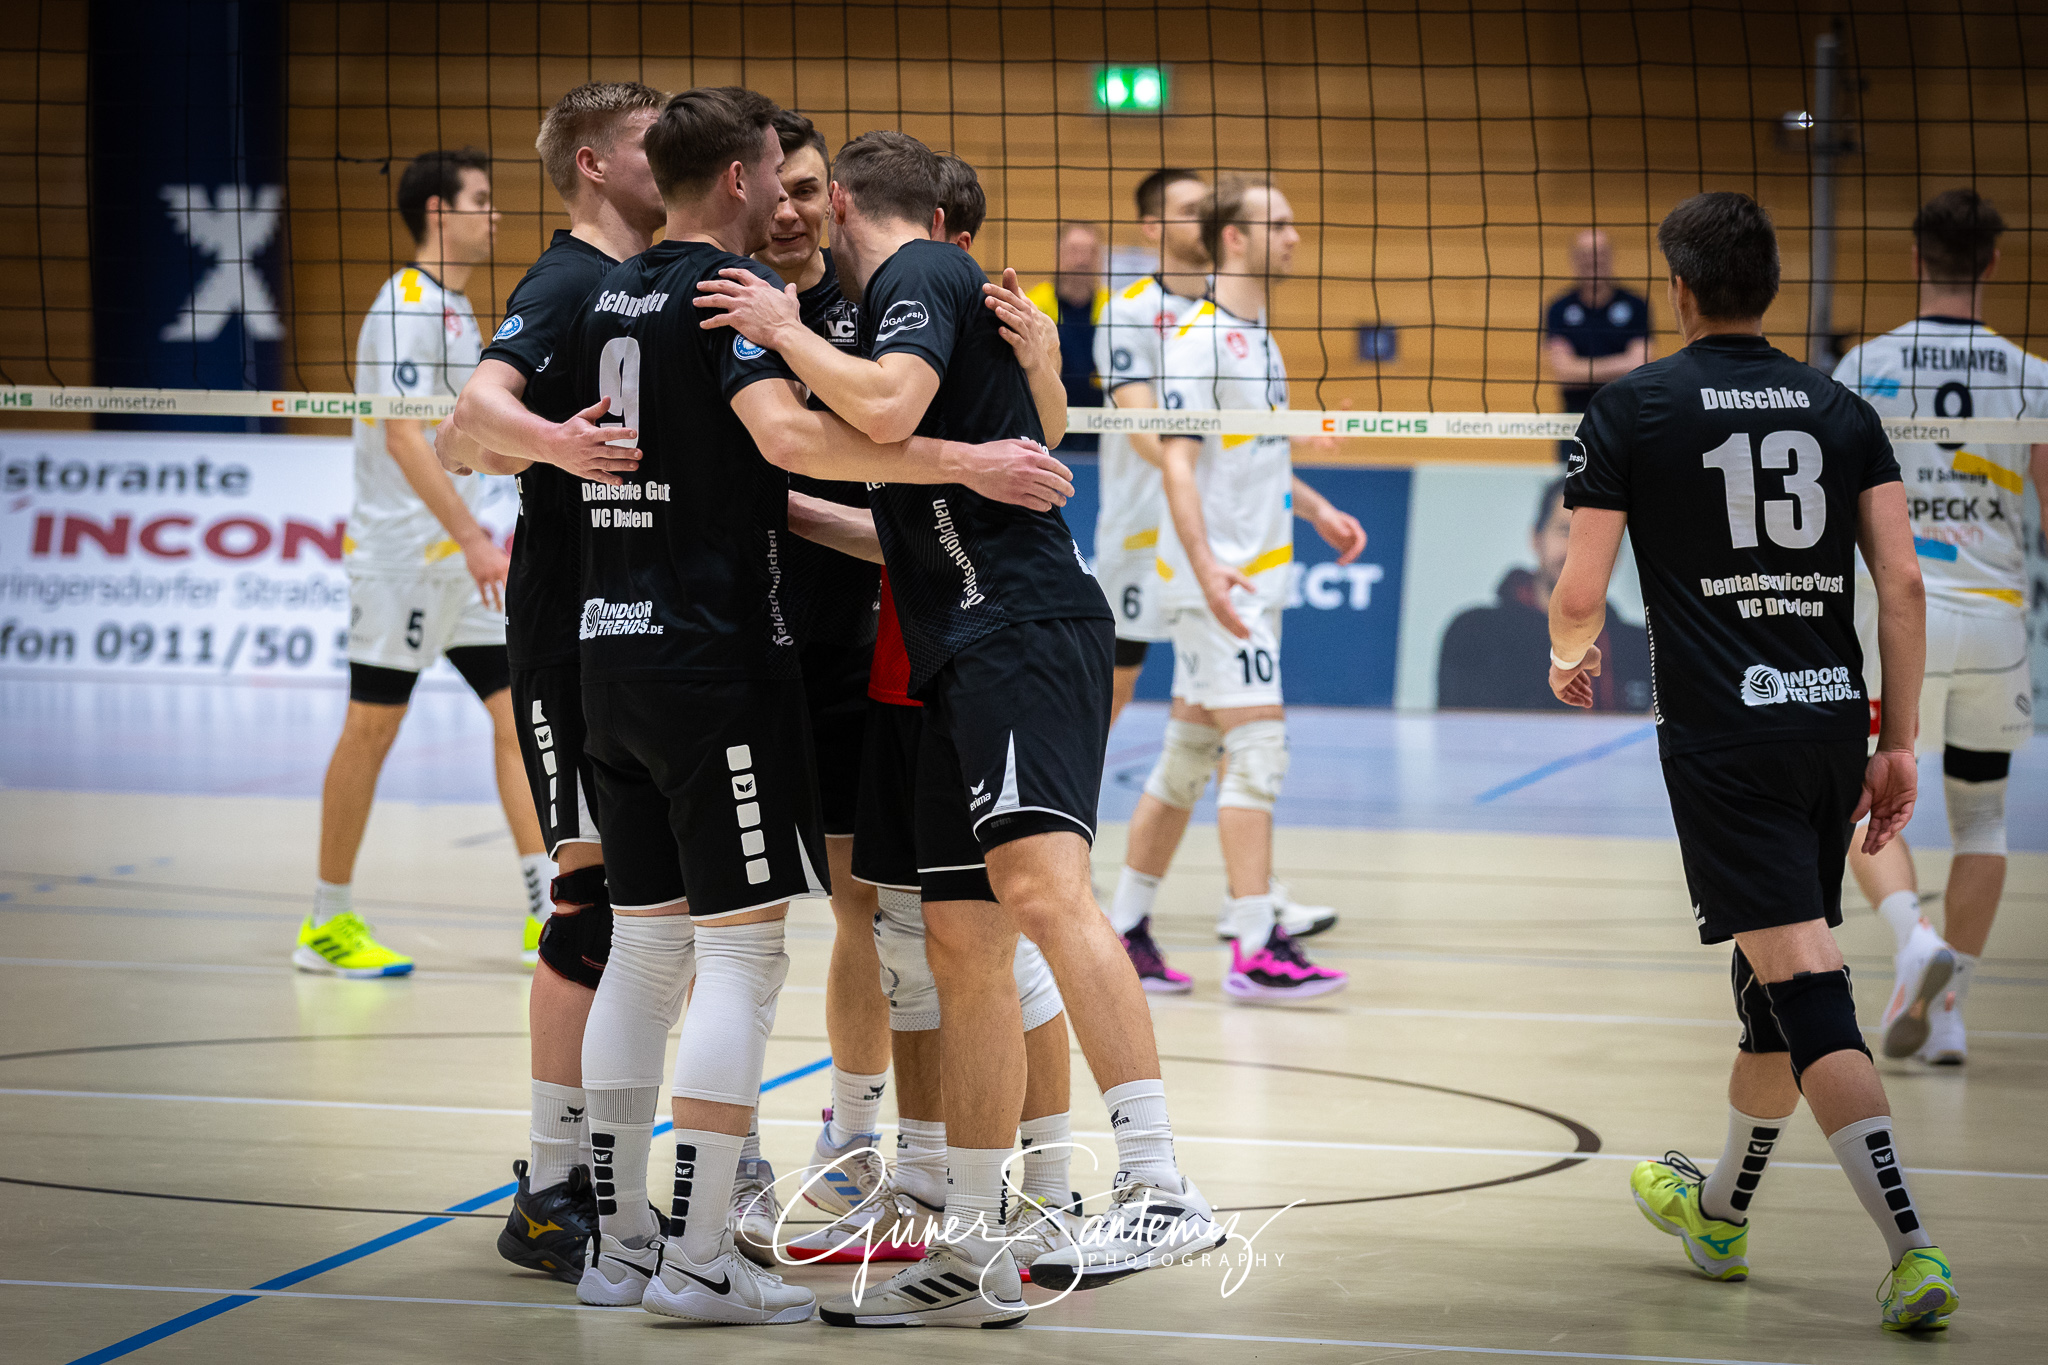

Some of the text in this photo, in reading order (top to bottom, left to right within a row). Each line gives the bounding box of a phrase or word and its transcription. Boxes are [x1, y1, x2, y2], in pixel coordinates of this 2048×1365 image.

[827, 320, 855, 337] VC
[1901, 347, 2008, 374] TAFELMAYER
[0, 393, 32, 406] HS
[50, 393, 177, 410] Ideen umsetzen
[600, 336, 641, 449] 9
[1700, 387, 1810, 410] Dutschke
[295, 400, 373, 415] FUCHS
[390, 401, 433, 416] Ideen
[1087, 415, 1221, 430] Ideen umsetzen
[1347, 419, 1428, 433] FUCHS
[1446, 419, 1492, 434] Ideen
[645, 481, 671, 502] Gut
[1702, 430, 1827, 549] 13
[591, 508, 611, 528] VC
[33, 514, 346, 561] INCON
[601, 601, 653, 620] INDOOR
[1123, 583, 1142, 621] 6
[1737, 598, 1763, 619] VC
[405, 609, 424, 649] 5
[1238, 649, 1273, 684] 10
[1783, 667, 1850, 687] INDOOR
[970, 792, 991, 811] erima
[990, 817, 1014, 829] erim
